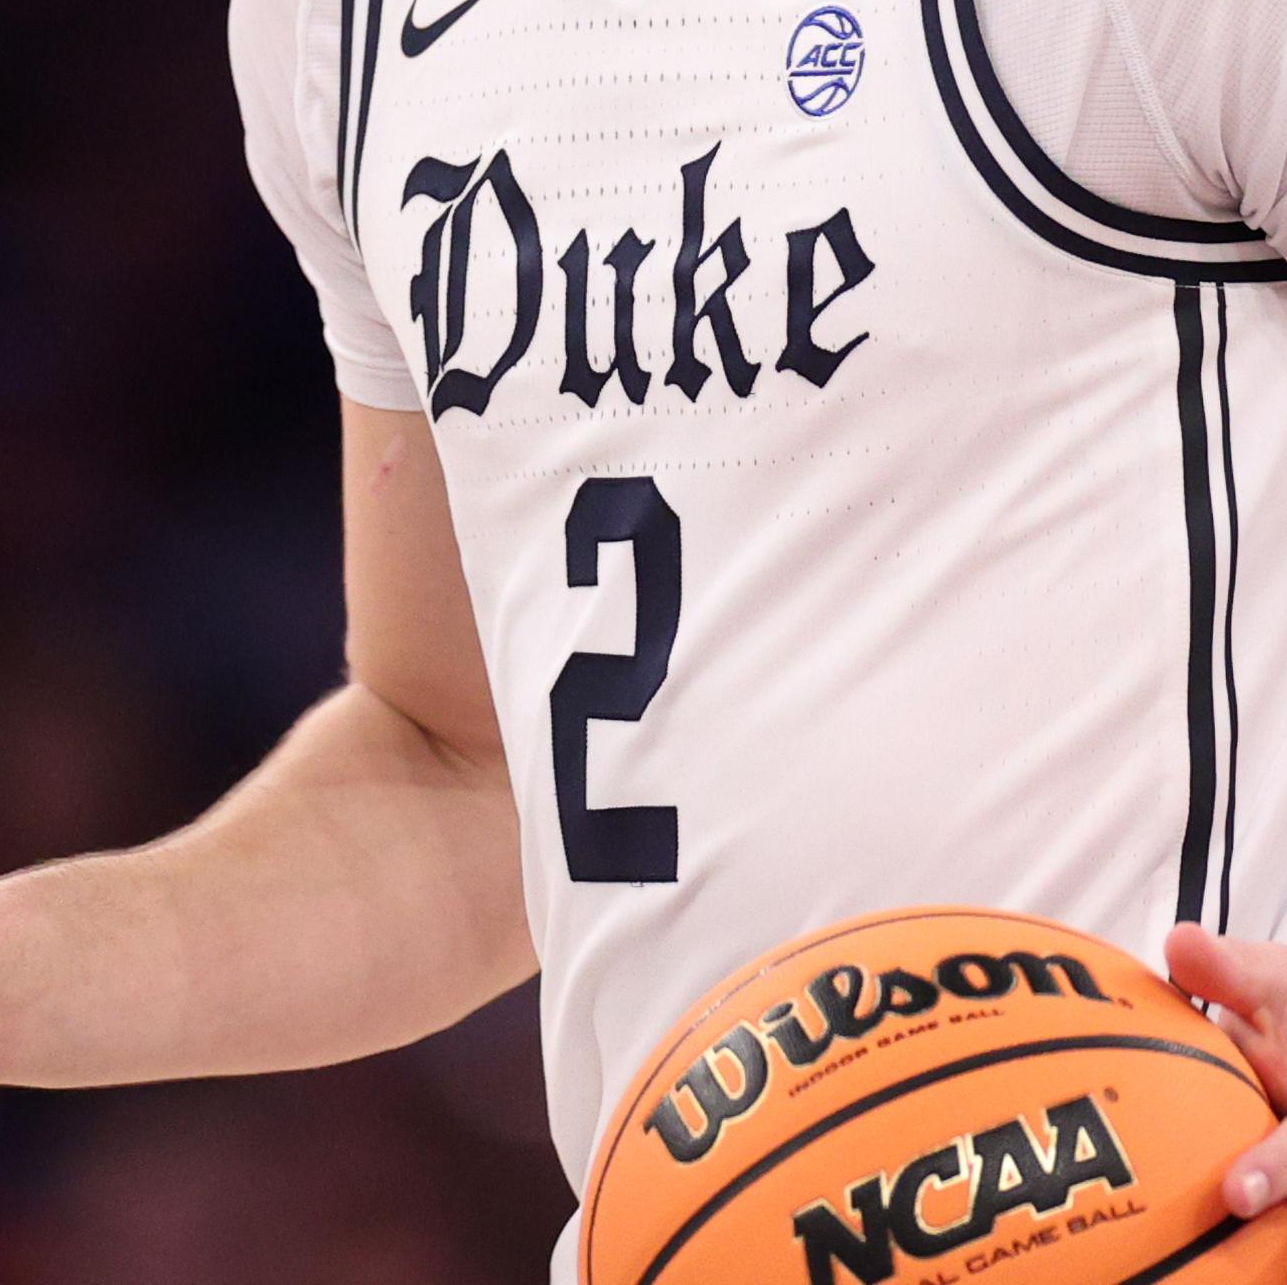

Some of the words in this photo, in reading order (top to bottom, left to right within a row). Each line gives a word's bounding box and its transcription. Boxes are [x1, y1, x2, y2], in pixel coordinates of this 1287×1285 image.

[796, 42, 863, 68] ACC
[401, 140, 876, 424] Duke
[549, 476, 681, 883] 2
[643, 950, 1114, 1165] Wilson
[788, 1047, 868, 1098] INDOOR
[877, 1020, 939, 1049] GAME
[949, 1009, 1005, 1024] BALL
[793, 1093, 1138, 1285] NCAA
[965, 1226, 1060, 1274] GAME
[1067, 1200, 1147, 1235] BALL
